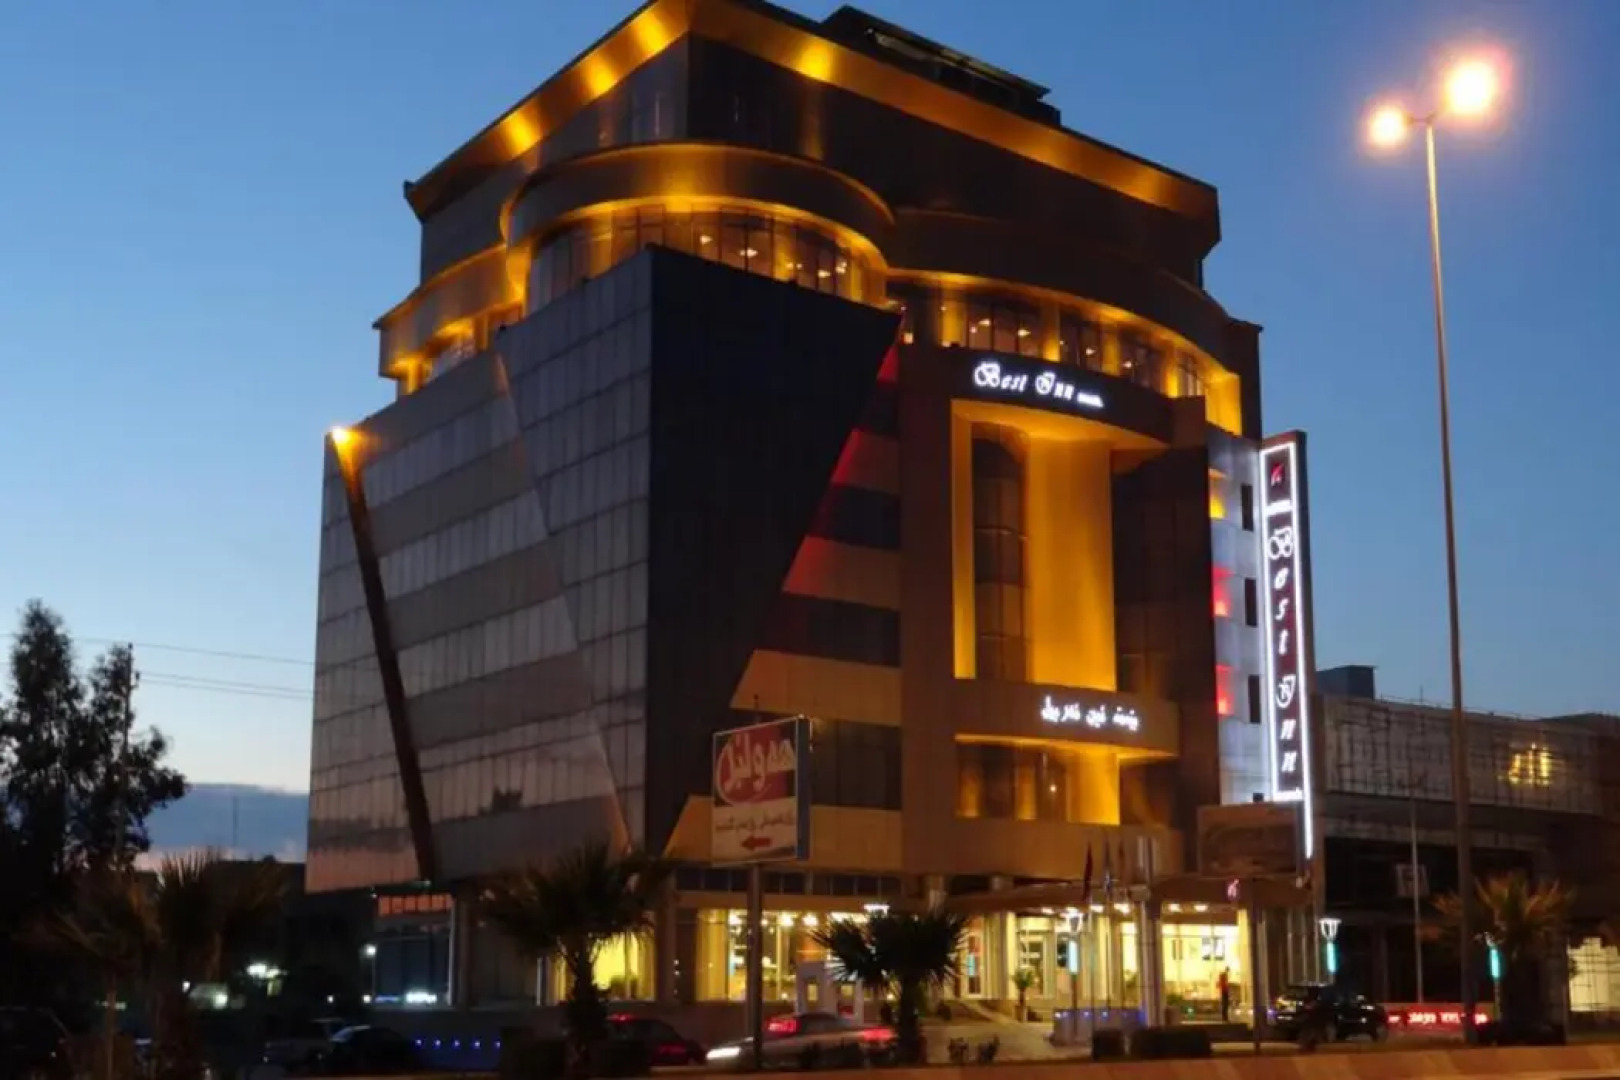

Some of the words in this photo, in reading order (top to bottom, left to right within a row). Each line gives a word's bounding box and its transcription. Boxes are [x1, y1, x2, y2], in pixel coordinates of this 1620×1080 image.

[974, 361, 1028, 392] Best
[1035, 371, 1075, 400] Inn
[1268, 525, 1294, 656] Best
